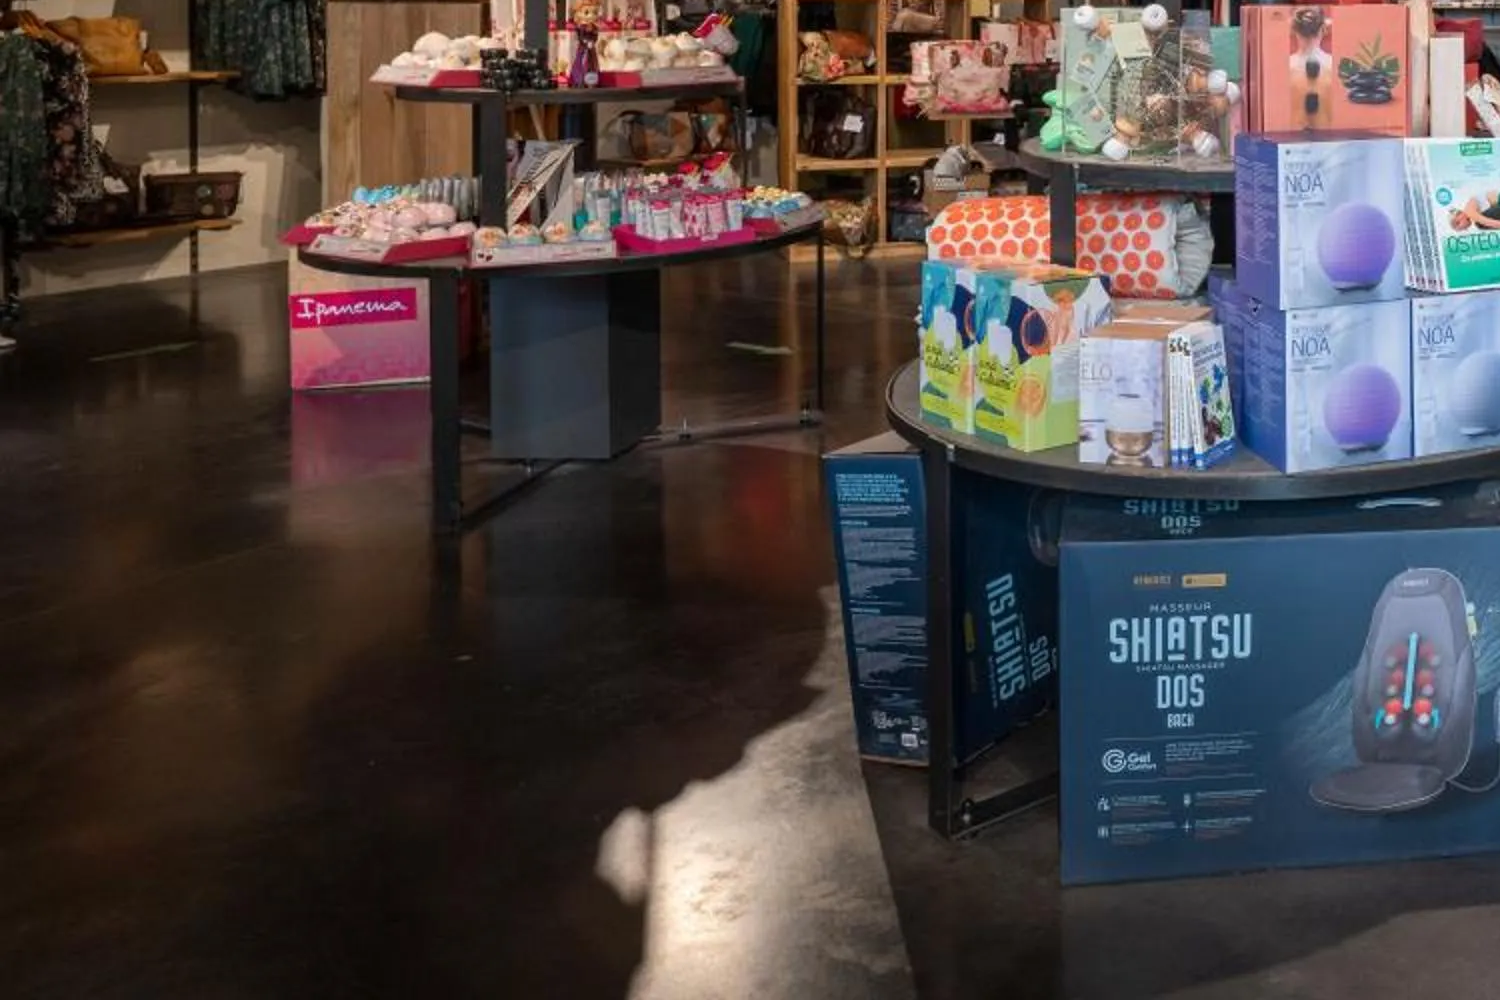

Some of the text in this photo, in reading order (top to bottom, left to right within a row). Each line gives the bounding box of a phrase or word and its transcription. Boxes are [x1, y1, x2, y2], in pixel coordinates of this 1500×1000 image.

[1285, 173, 1324, 193] NOA
[296, 298, 409, 324] Ipanema
[1418, 325, 1455, 345] NOA
[1292, 336, 1331, 357] NOA
[1123, 499, 1241, 516] SHIATSU
[1160, 515, 1202, 529] DOS
[1149, 601, 1212, 613] MASSEUR
[985, 573, 1026, 700] SHIATSU
[1108, 613, 1253, 664] SHIATSU
[1029, 635, 1051, 681] DOS
[1156, 673, 1206, 709] DOS
[1167, 713, 1195, 728] BACK
